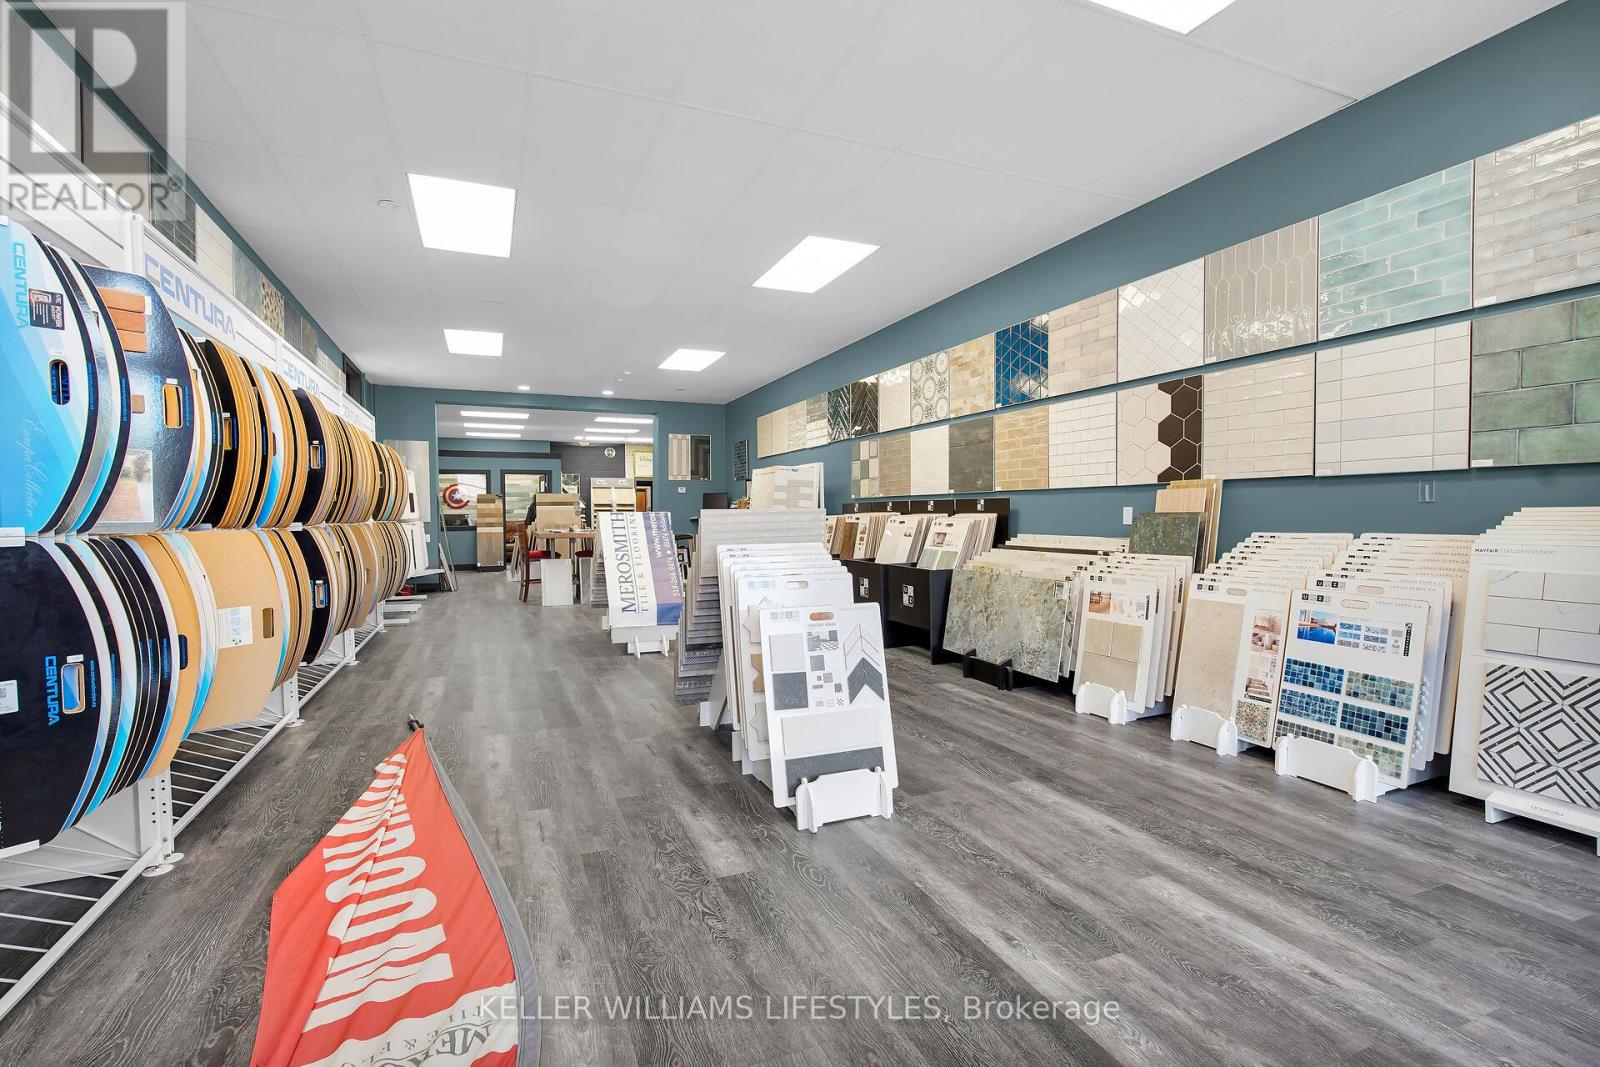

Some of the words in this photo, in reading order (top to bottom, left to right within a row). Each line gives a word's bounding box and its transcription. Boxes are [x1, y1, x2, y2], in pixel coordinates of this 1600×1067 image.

[13, 242, 29, 328] CENTURA
[144, 252, 236, 341] CENTURA
[283, 358, 321, 396] CENTURA
[610, 512, 638, 614] MEROSMITH
[639, 584, 649, 615] TILE
[44, 655, 61, 728] CENTURA
